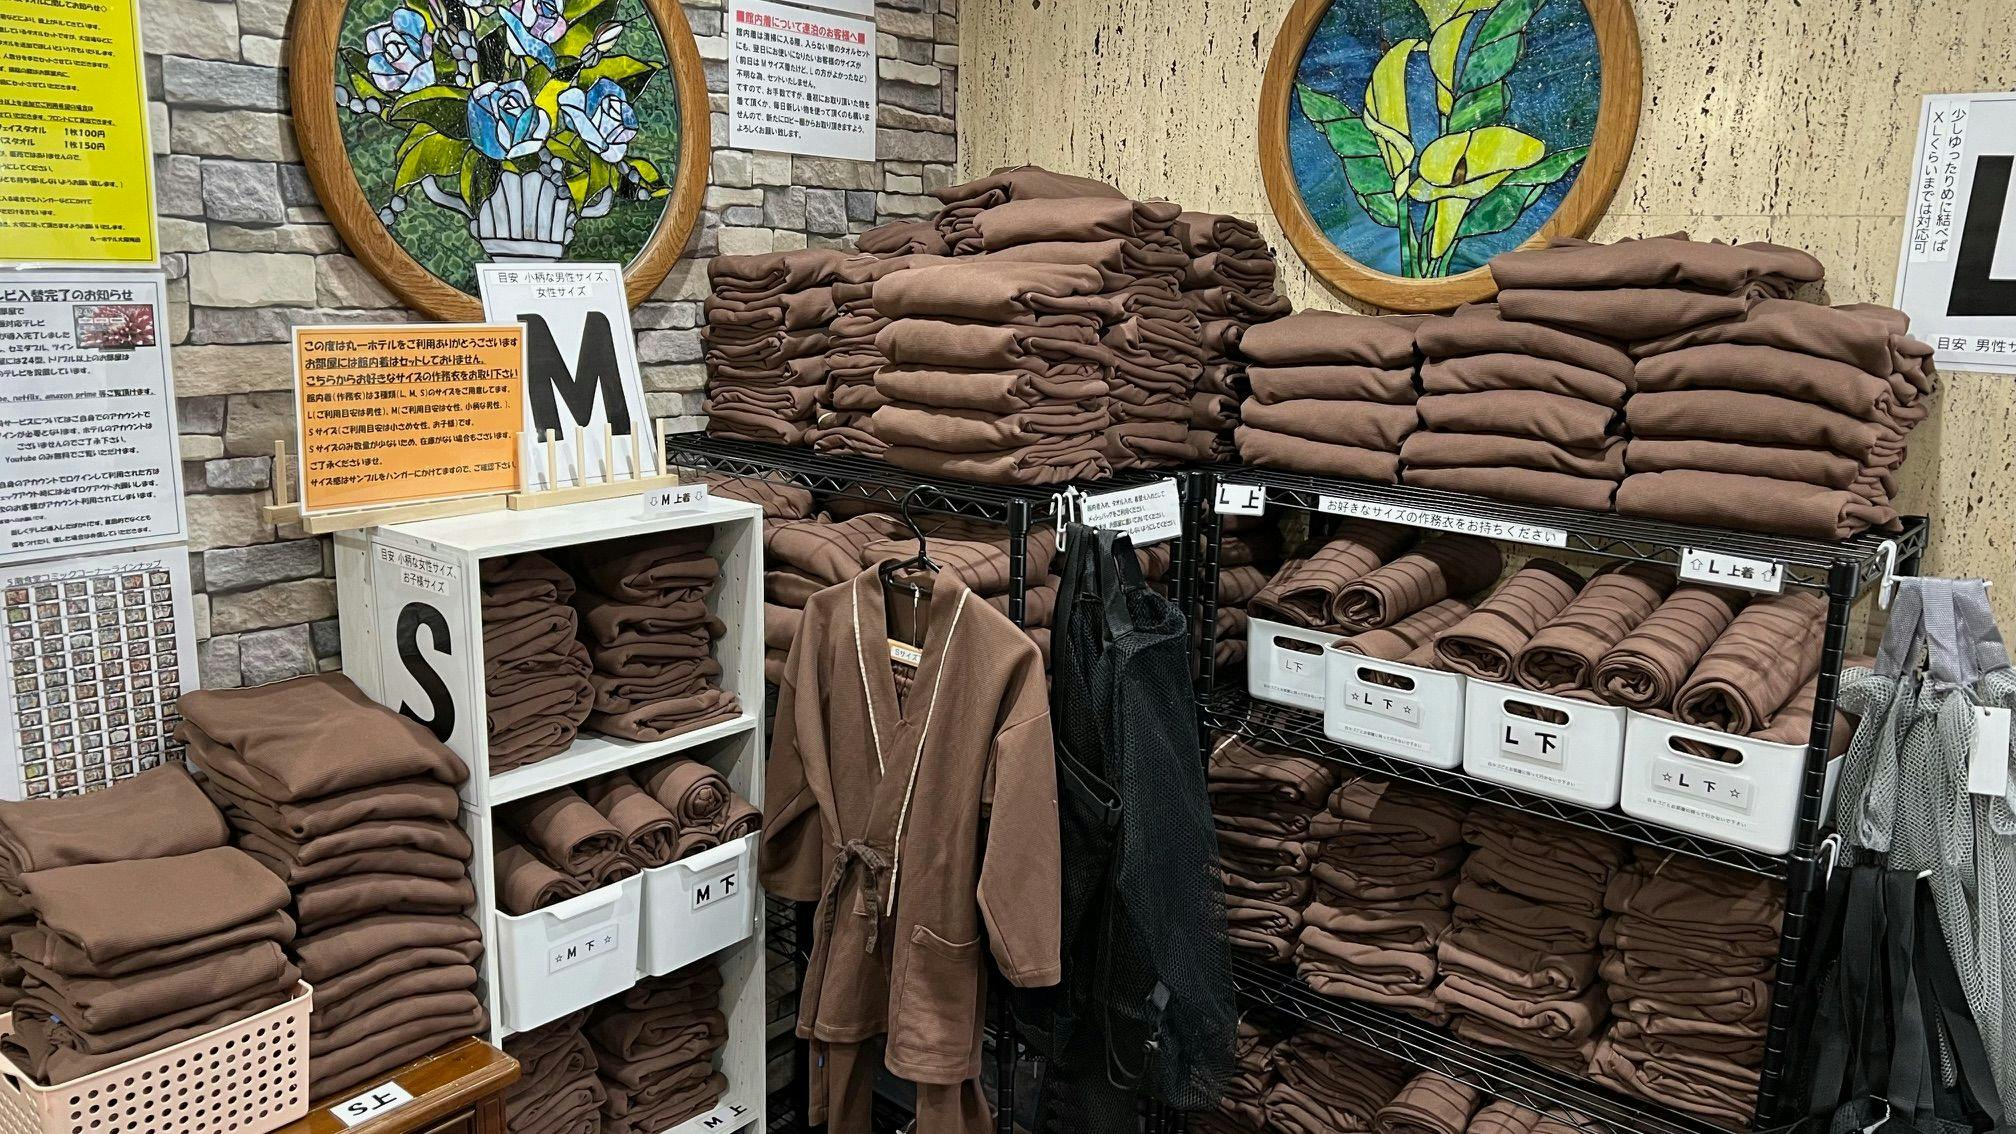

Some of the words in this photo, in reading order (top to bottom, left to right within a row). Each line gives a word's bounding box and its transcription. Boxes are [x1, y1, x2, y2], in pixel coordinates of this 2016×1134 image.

[1933, 108, 1967, 252] 少しゆったりめに結べば
[1946, 155, 2016, 316] L
[498, 272, 518, 284] 目安
[536, 286, 586, 298] 女性サイズ
[1938, 337, 1966, 351] 目安
[516, 311, 631, 443] M
[661, 494, 670, 506] M
[1220, 488, 1229, 505] L
[1242, 490, 1260, 509] 上
[1327, 500, 1557, 542] お好きなサイズの作務衣をお持ちください
[381, 548, 394, 562] 目安
[1709, 560, 1719, 574] L
[1727, 565, 1754, 579] 上着
[403, 572, 444, 592] お子様サイズ
[397, 602, 455, 743] S
[1364, 693, 1372, 705] L
[1383, 698, 1393, 710] 下
[1505, 726, 1518, 745] L
[1535, 732, 1557, 754] 下
[1679, 773, 1689, 787] L
[1704, 780, 1716, 793] 下
[696, 885, 710, 905] M
[720, 873, 735, 894] 下
[567, 946, 577, 960] M
[586, 940, 595, 951] 下
[703, 1116, 724, 1129] M
[729, 1105, 748, 1117] 上
